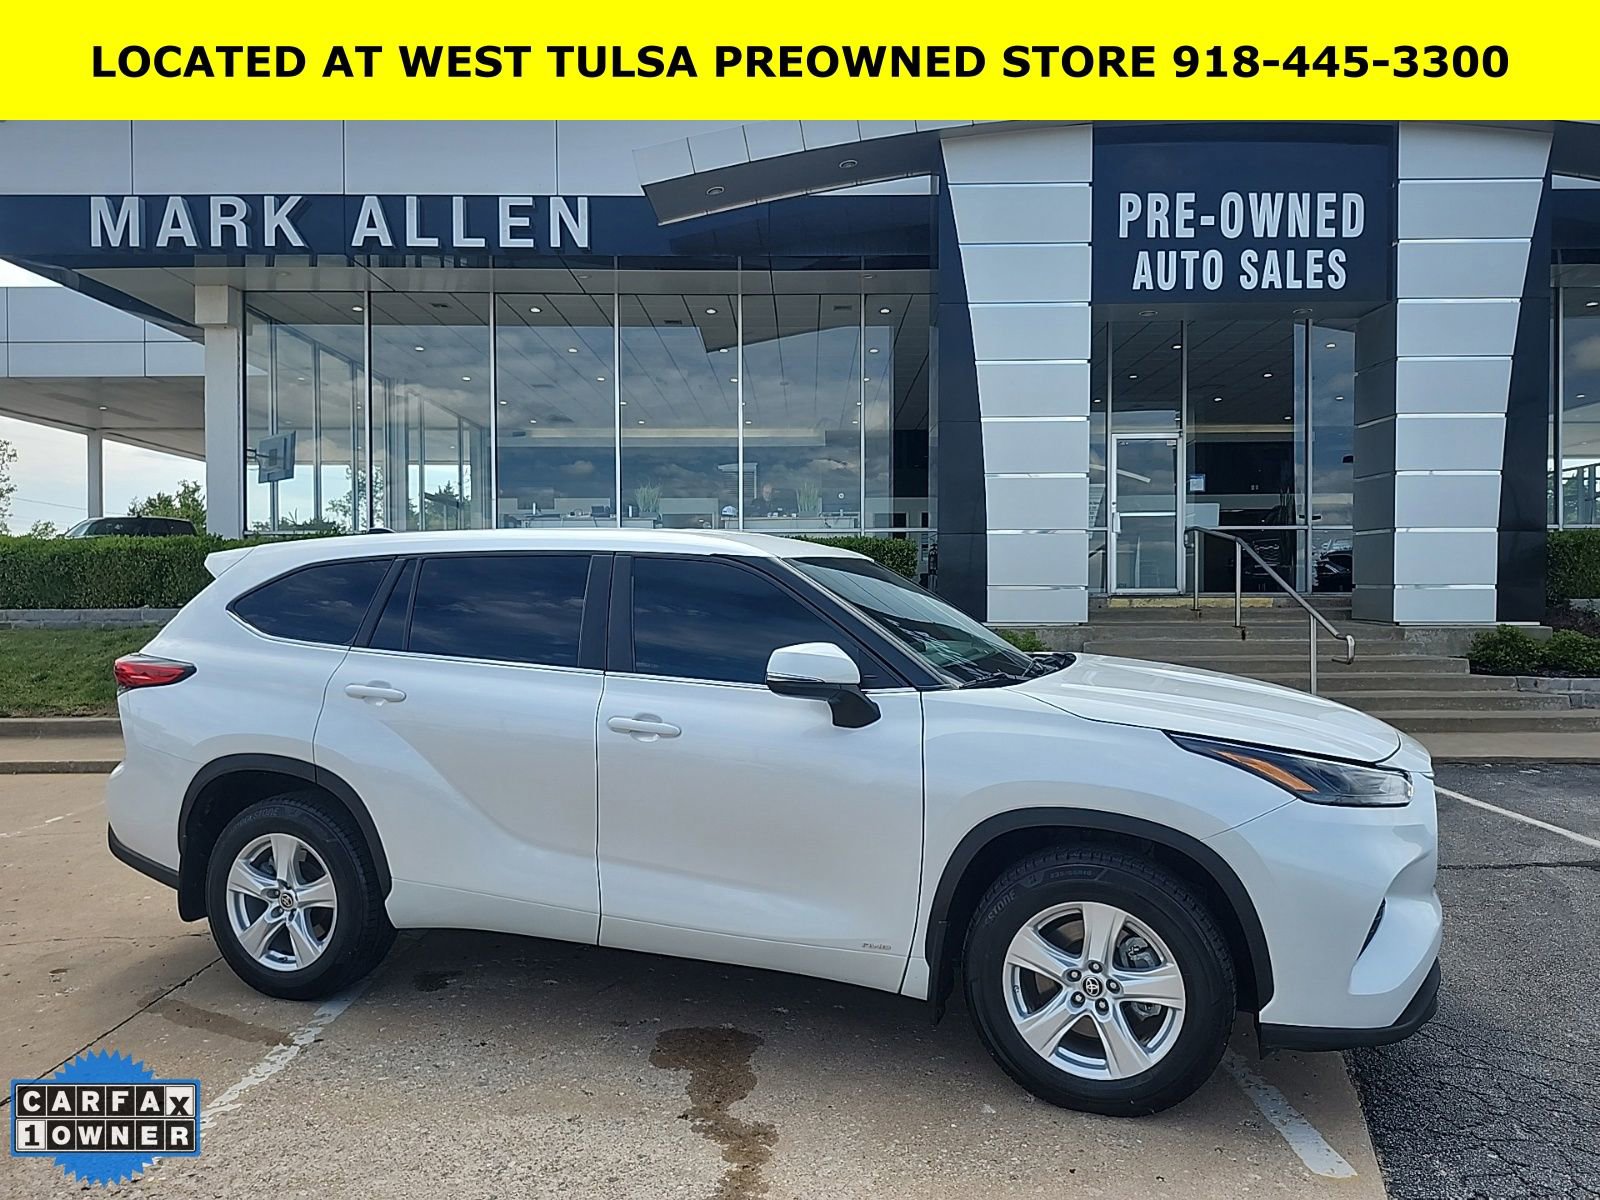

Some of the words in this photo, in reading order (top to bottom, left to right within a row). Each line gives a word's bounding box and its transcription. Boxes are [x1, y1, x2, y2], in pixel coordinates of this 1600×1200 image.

[90, 195, 306, 249] MARK
[351, 195, 592, 249] ALLEN
[1119, 191, 1366, 240] PRE-OWNED
[1132, 249, 1224, 291] AUTO
[1239, 249, 1348, 291] SALES
